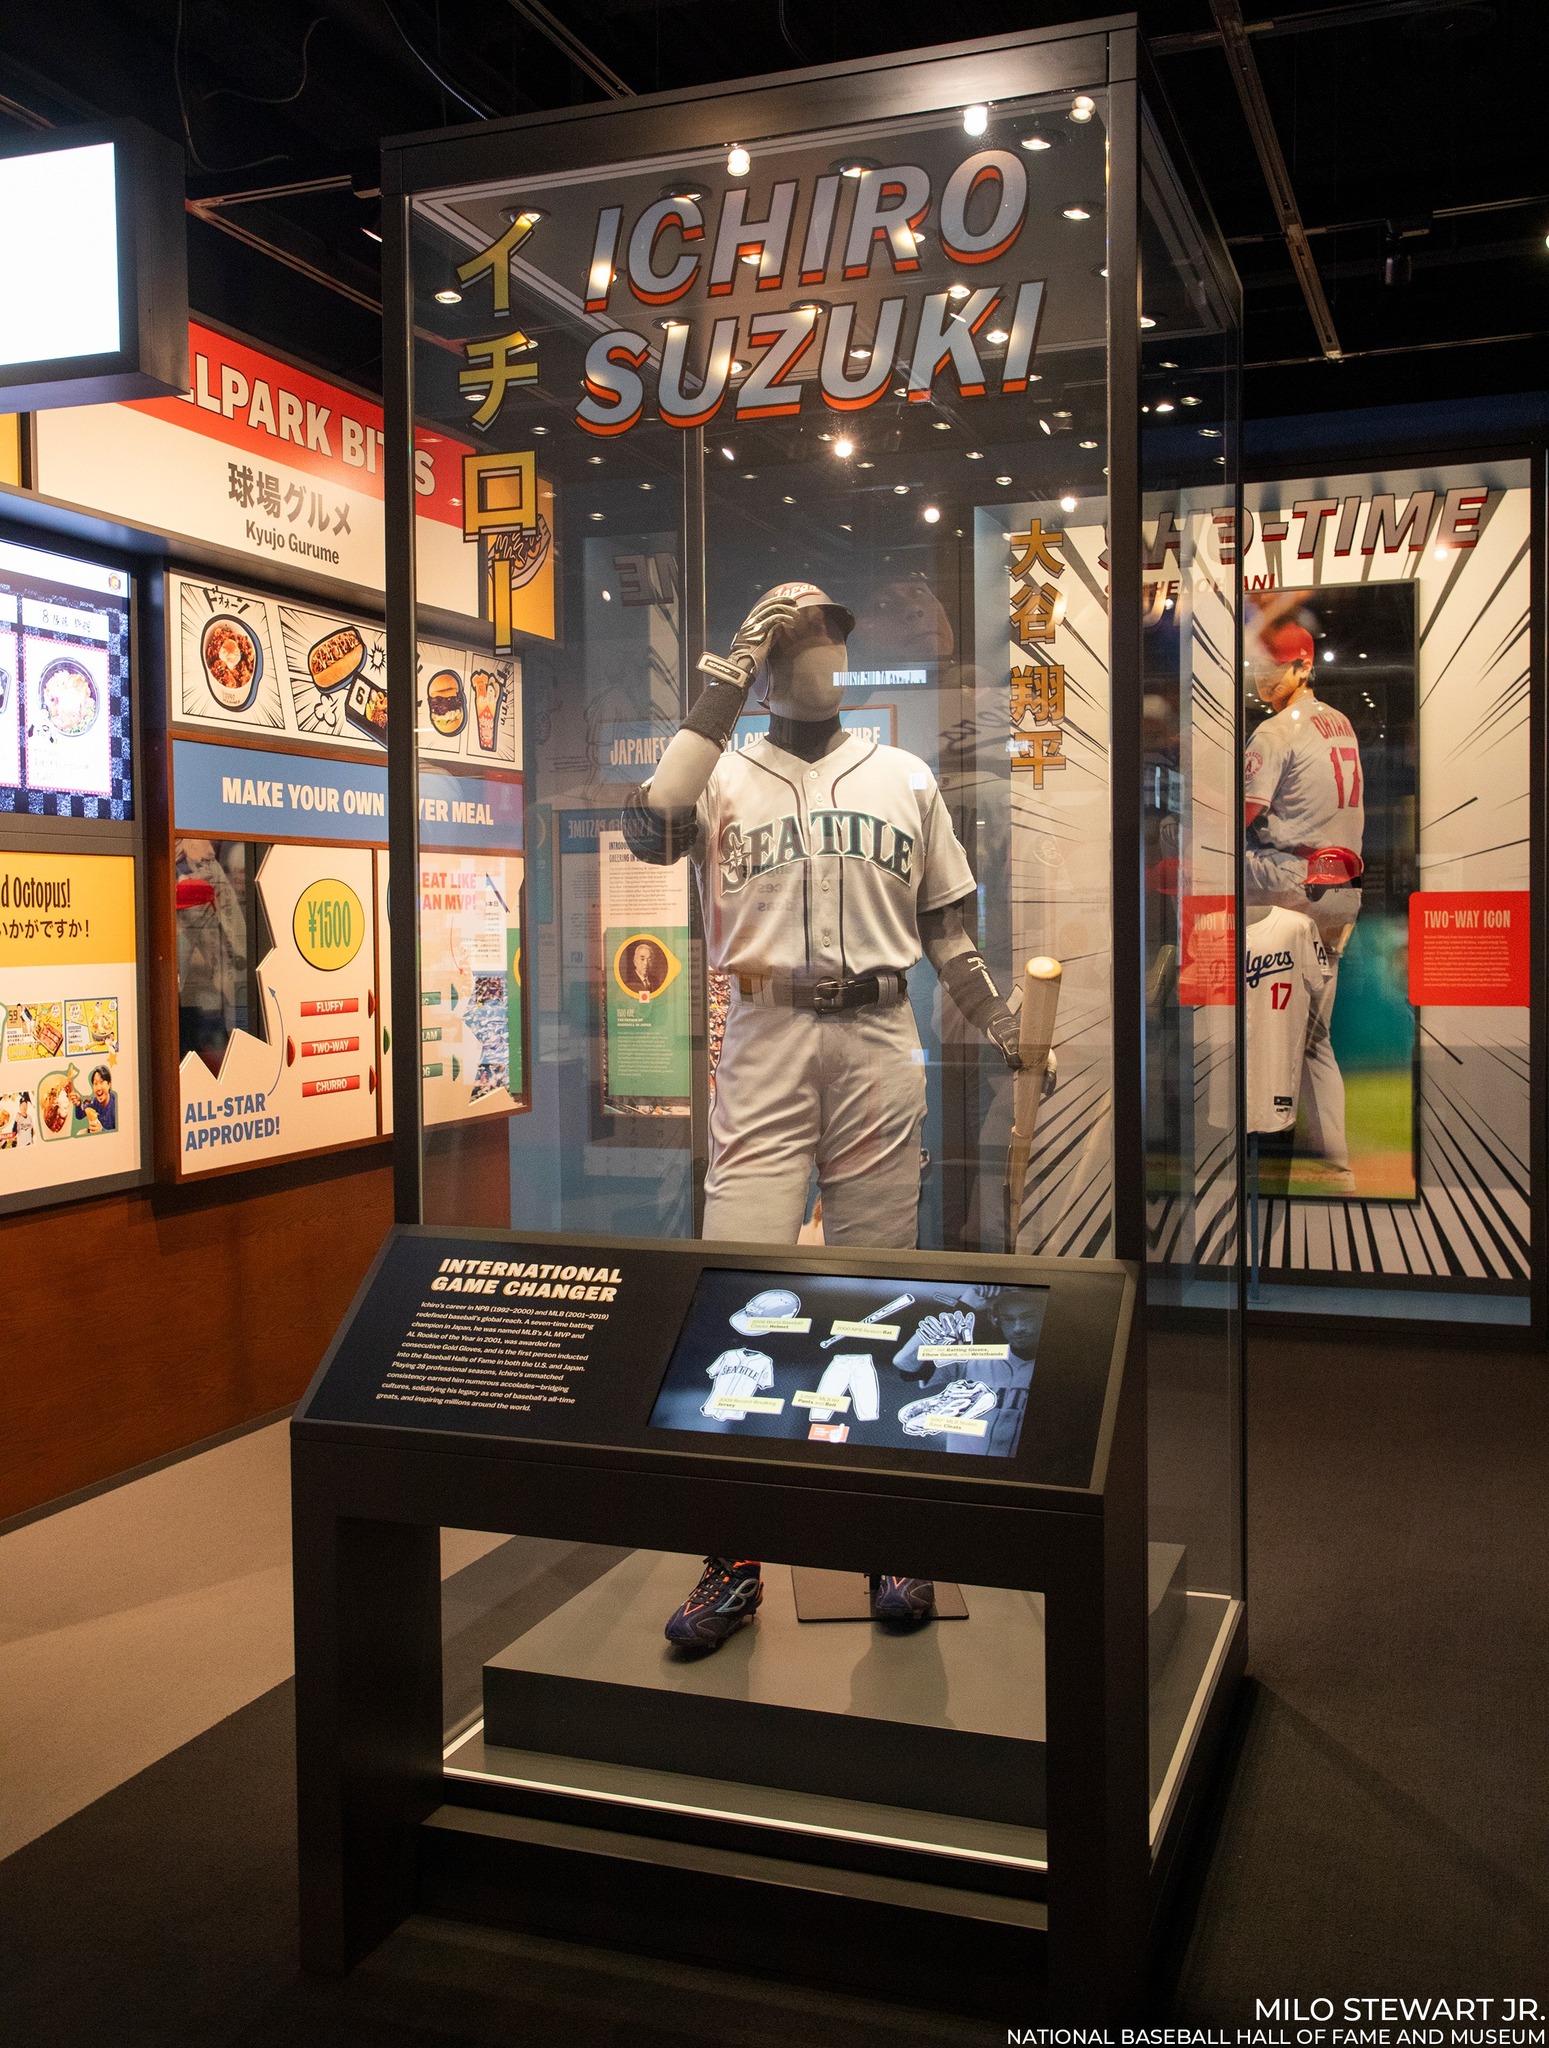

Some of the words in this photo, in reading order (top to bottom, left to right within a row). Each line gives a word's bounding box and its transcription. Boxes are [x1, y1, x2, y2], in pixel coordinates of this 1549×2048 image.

[584, 149, 1029, 313] ICHIRO
[575, 281, 1047, 436] SUZUKI
[178, 352, 333, 458] LPARK
[341, 415, 435, 497] BIS
[457, 213, 540, 656] イチロー
[228, 462, 352, 536] 球場グルメ
[246, 519, 285, 550] Kyujo
[288, 533, 340, 565] Gurume
[1098, 486, 1489, 571] HO-TIME
[1008, 518, 1067, 790] 大谷翔平
[611, 737, 673, 765] JAPANES
[1330, 747, 1361, 809] 17
[222, 777, 283, 808] MAKE
[287, 783, 340, 813] YOUR
[343, 789, 385, 817] OWN
[452, 801, 494, 826] MEAL
[719, 808, 915, 897] SEATTLE
[13, 876, 71, 912] Octopus!
[422, 872, 447, 888] EAT
[450, 873, 477, 889] LIKE
[422, 894, 442, 910] AN
[445, 895, 477, 910] MVP!
[308, 899, 352, 949] ¥1500
[1424, 910, 1480, 928] TWO-WAY
[1483, 910, 1511, 928] ICON
[1246, 951, 1294, 988] gers
[316, 1001, 344, 1013] FLUFFY
[1271, 983, 1292, 1010] 17
[312, 1041, 349, 1055] TWO-WAY
[316, 1078, 347, 1093] CHURRO
[185, 1093, 266, 1125] ALL-STAR
[185, 1116, 281, 1152] APPROVED!
[438, 1258, 623, 1283] INTERNATIONAL
[431, 1276, 500, 1294] GAME
[503, 1281, 617, 1302] CHANGER
[402, 1342, 441, 1350] consecutive
[459, 1345, 482, 1353] Gloves,
[423, 1353, 451, 1361] Baseball
[387, 1372, 426, 1381] consistency
[392, 1361, 416, 1370] Playing
[426, 1365, 467, 1373] professional
[722, 1364, 760, 1380] SEATTLE
[382, 1382, 410, 1390] cultures,
[412, 1384, 446, 1394] solidifying
[458, 1388, 480, 1397] legacy
[512, 1393, 547, 1401] baseball's
[548, 1396, 575, 1404] all-time
